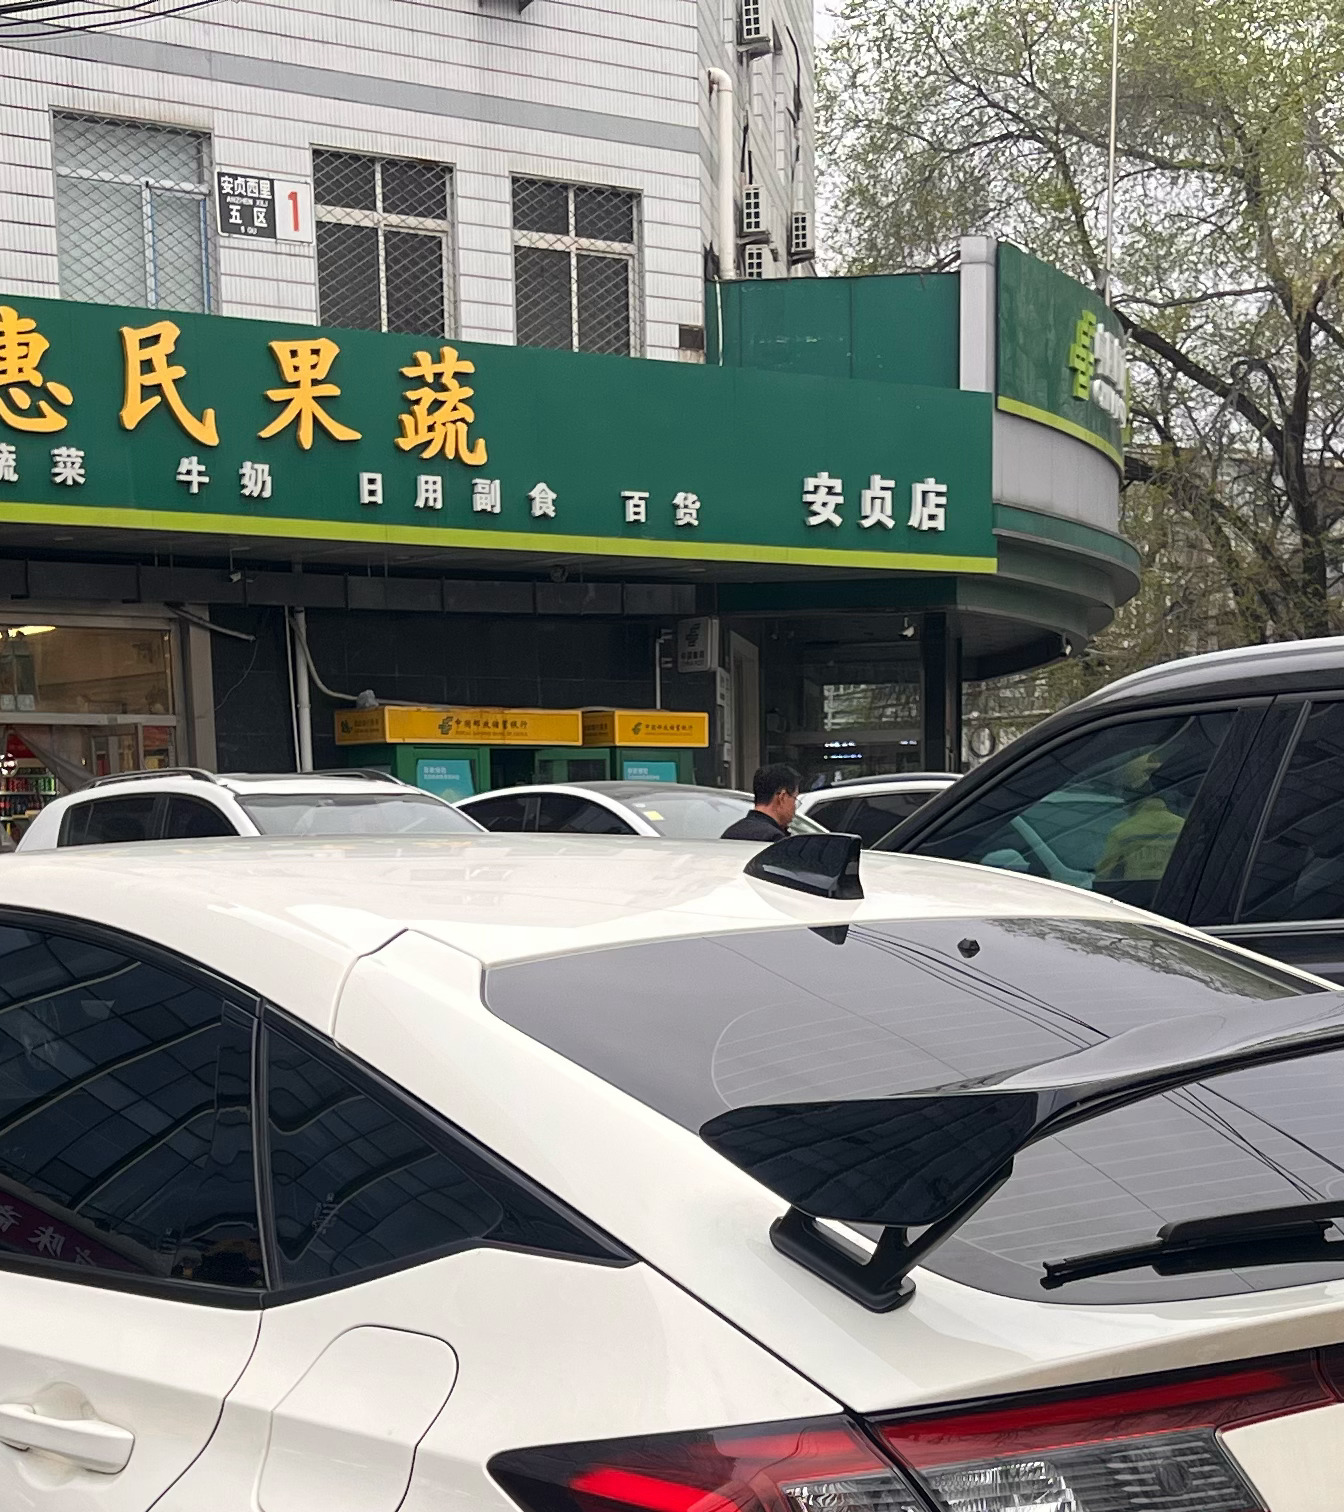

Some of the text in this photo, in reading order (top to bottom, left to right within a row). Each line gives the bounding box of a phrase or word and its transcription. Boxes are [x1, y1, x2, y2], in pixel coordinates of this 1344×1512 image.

[220, 176, 273, 199] 安贞西里
[228, 204, 268, 228] 五区
[287, 190, 300, 232] 1
[176, 455, 273, 499] 牛奶
[359, 471, 558, 519] 日用副食
[621, 490, 701, 527] 百货
[803, 471, 948, 532] 安贞店
